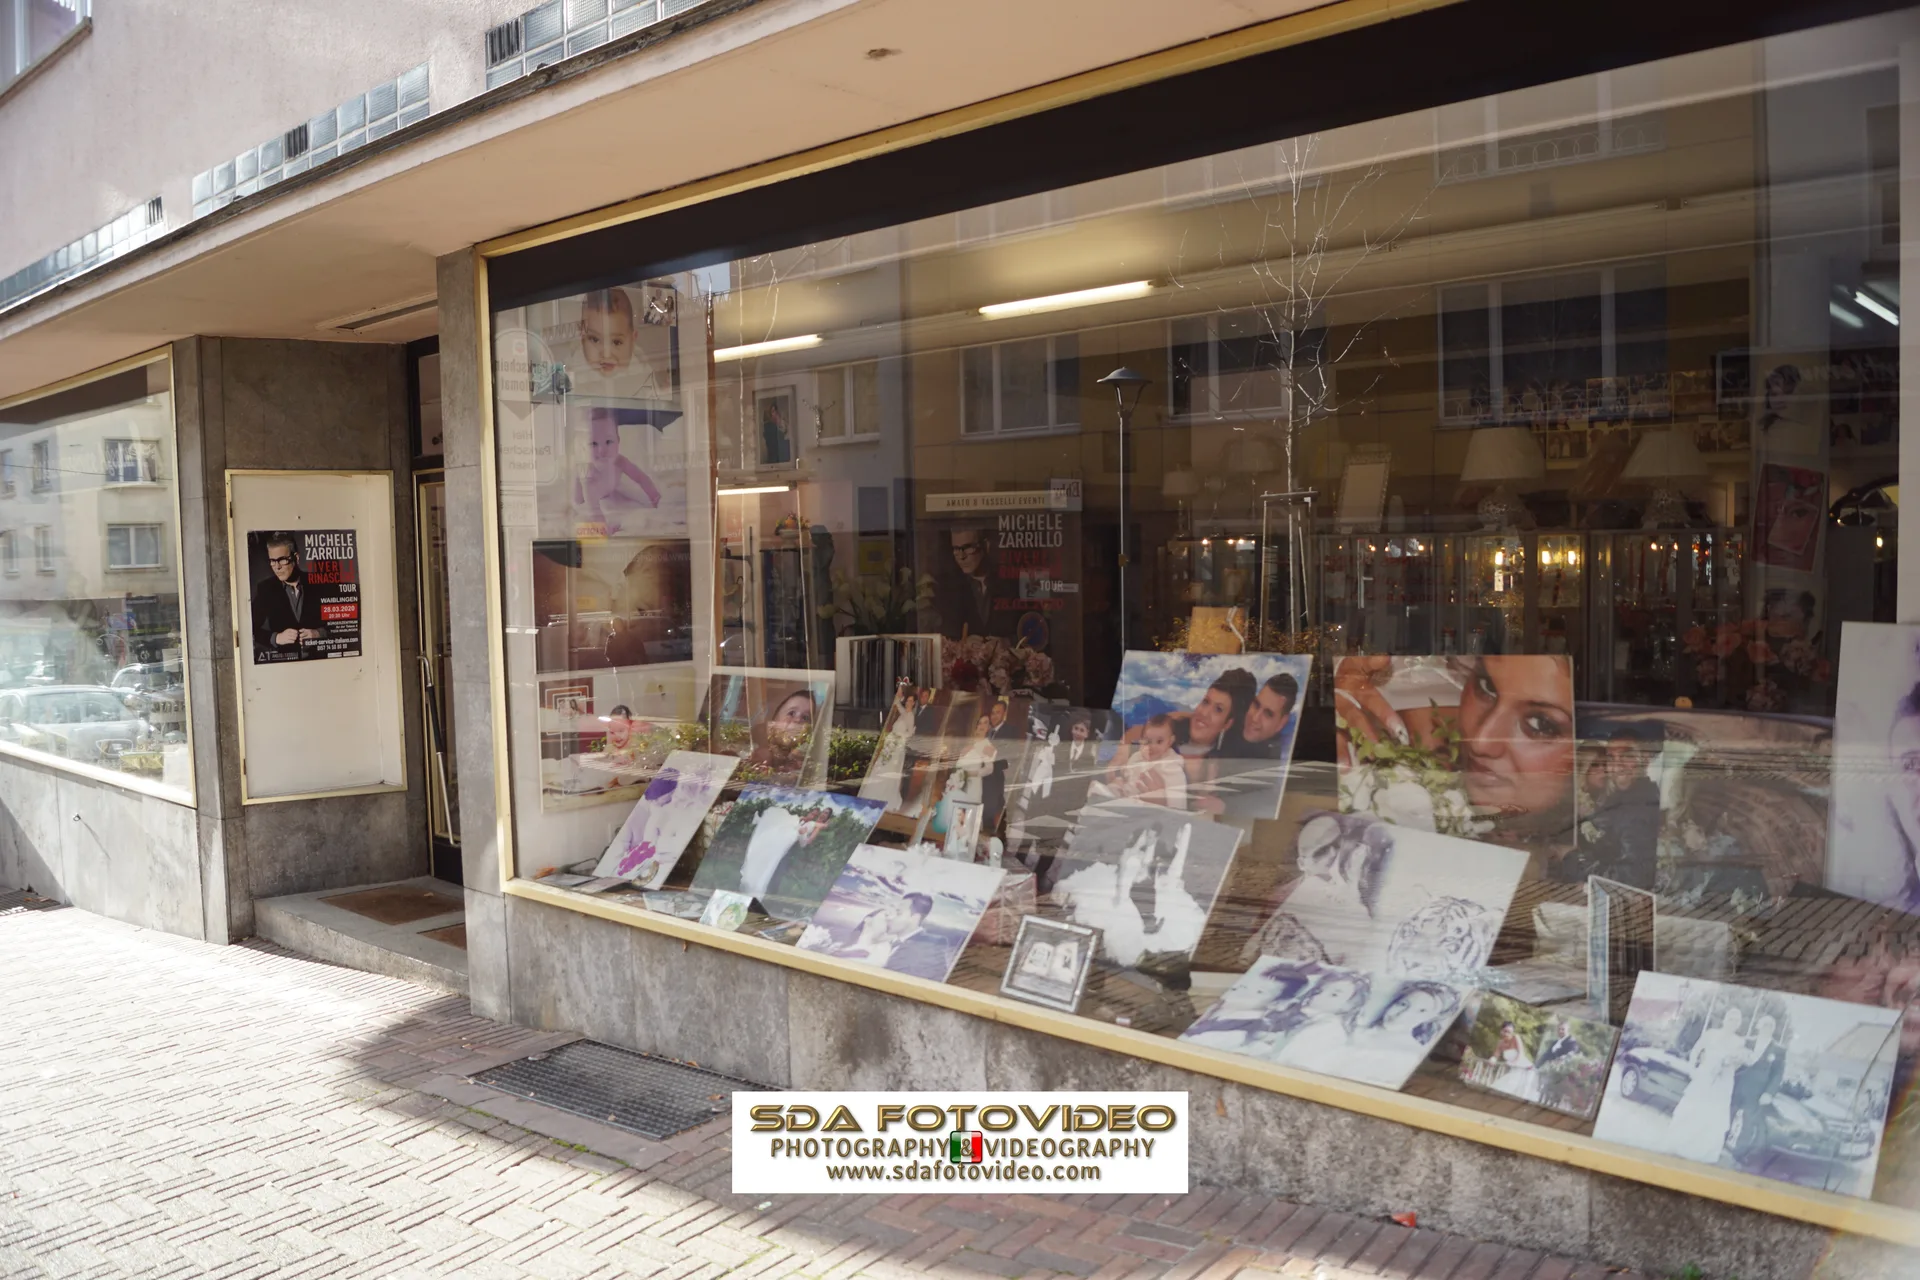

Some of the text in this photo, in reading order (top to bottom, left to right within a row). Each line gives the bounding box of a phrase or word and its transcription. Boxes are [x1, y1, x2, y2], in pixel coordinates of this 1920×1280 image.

[947, 497, 970, 508] AMATO
[982, 496, 1016, 507] TASSELLI
[1018, 495, 1045, 506] EVENTI
[998, 513, 1063, 532] MICHELE
[304, 533, 354, 547] MICHELE
[998, 531, 1063, 549] ZARRILLO
[305, 546, 355, 561] ZARRILLO
[308, 572, 356, 585] RINASC
[339, 583, 357, 593] TOUR
[1039, 579, 1064, 593] TOUR
[320, 596, 358, 604] WAIBLINGEN
[323, 605, 356, 613] 28.03.2020
